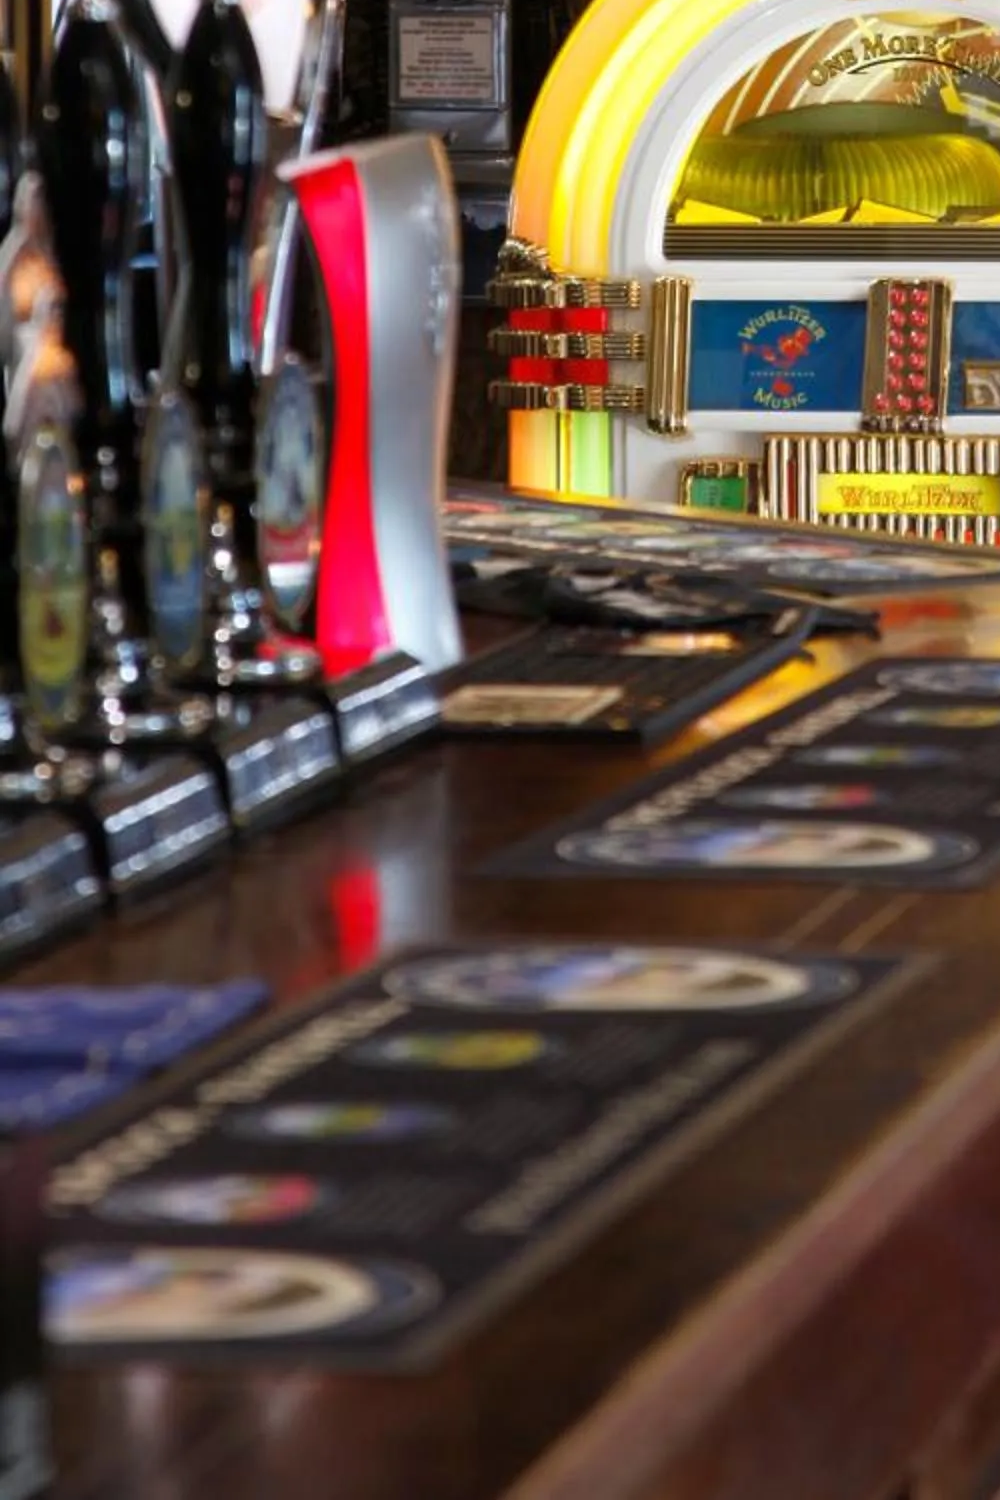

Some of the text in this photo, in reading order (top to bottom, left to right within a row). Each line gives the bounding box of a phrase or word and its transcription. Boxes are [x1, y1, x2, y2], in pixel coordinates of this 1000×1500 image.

[737, 304, 827, 342] WURLITZER
[753, 387, 808, 409] MUSIC
[837, 483, 984, 511] WURLITZER
